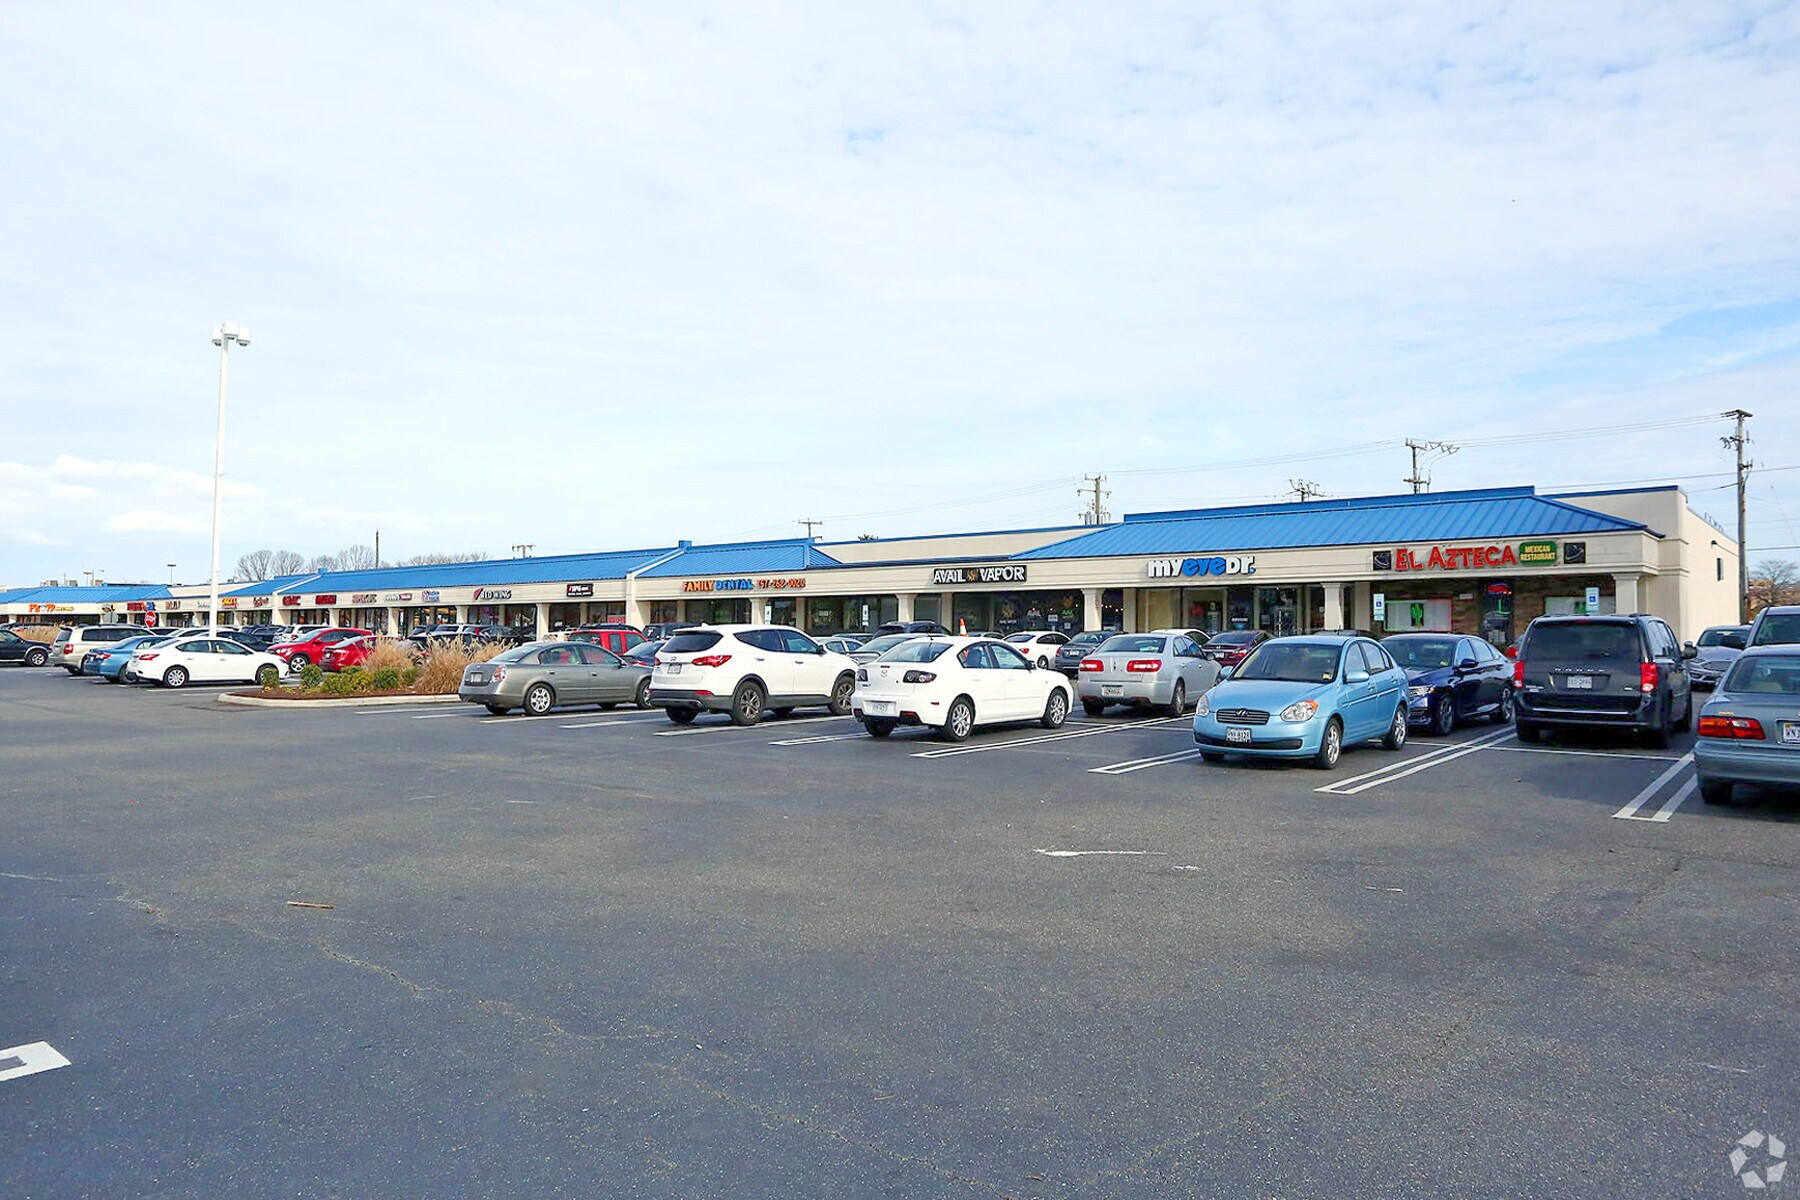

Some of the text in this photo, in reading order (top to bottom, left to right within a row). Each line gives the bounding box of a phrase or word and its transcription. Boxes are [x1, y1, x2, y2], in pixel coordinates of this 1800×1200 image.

[1524, 545, 1551, 553] MEXICAN
[1395, 545, 1517, 571] EL AZTECA
[1520, 552, 1556, 561] RESTAURANT
[934, 566, 1025, 583] AVAIL VAPOR
[682, 581, 714, 592] FAMILY
[715, 579, 753, 590] DENTAL
[480, 590, 494, 599] RED
